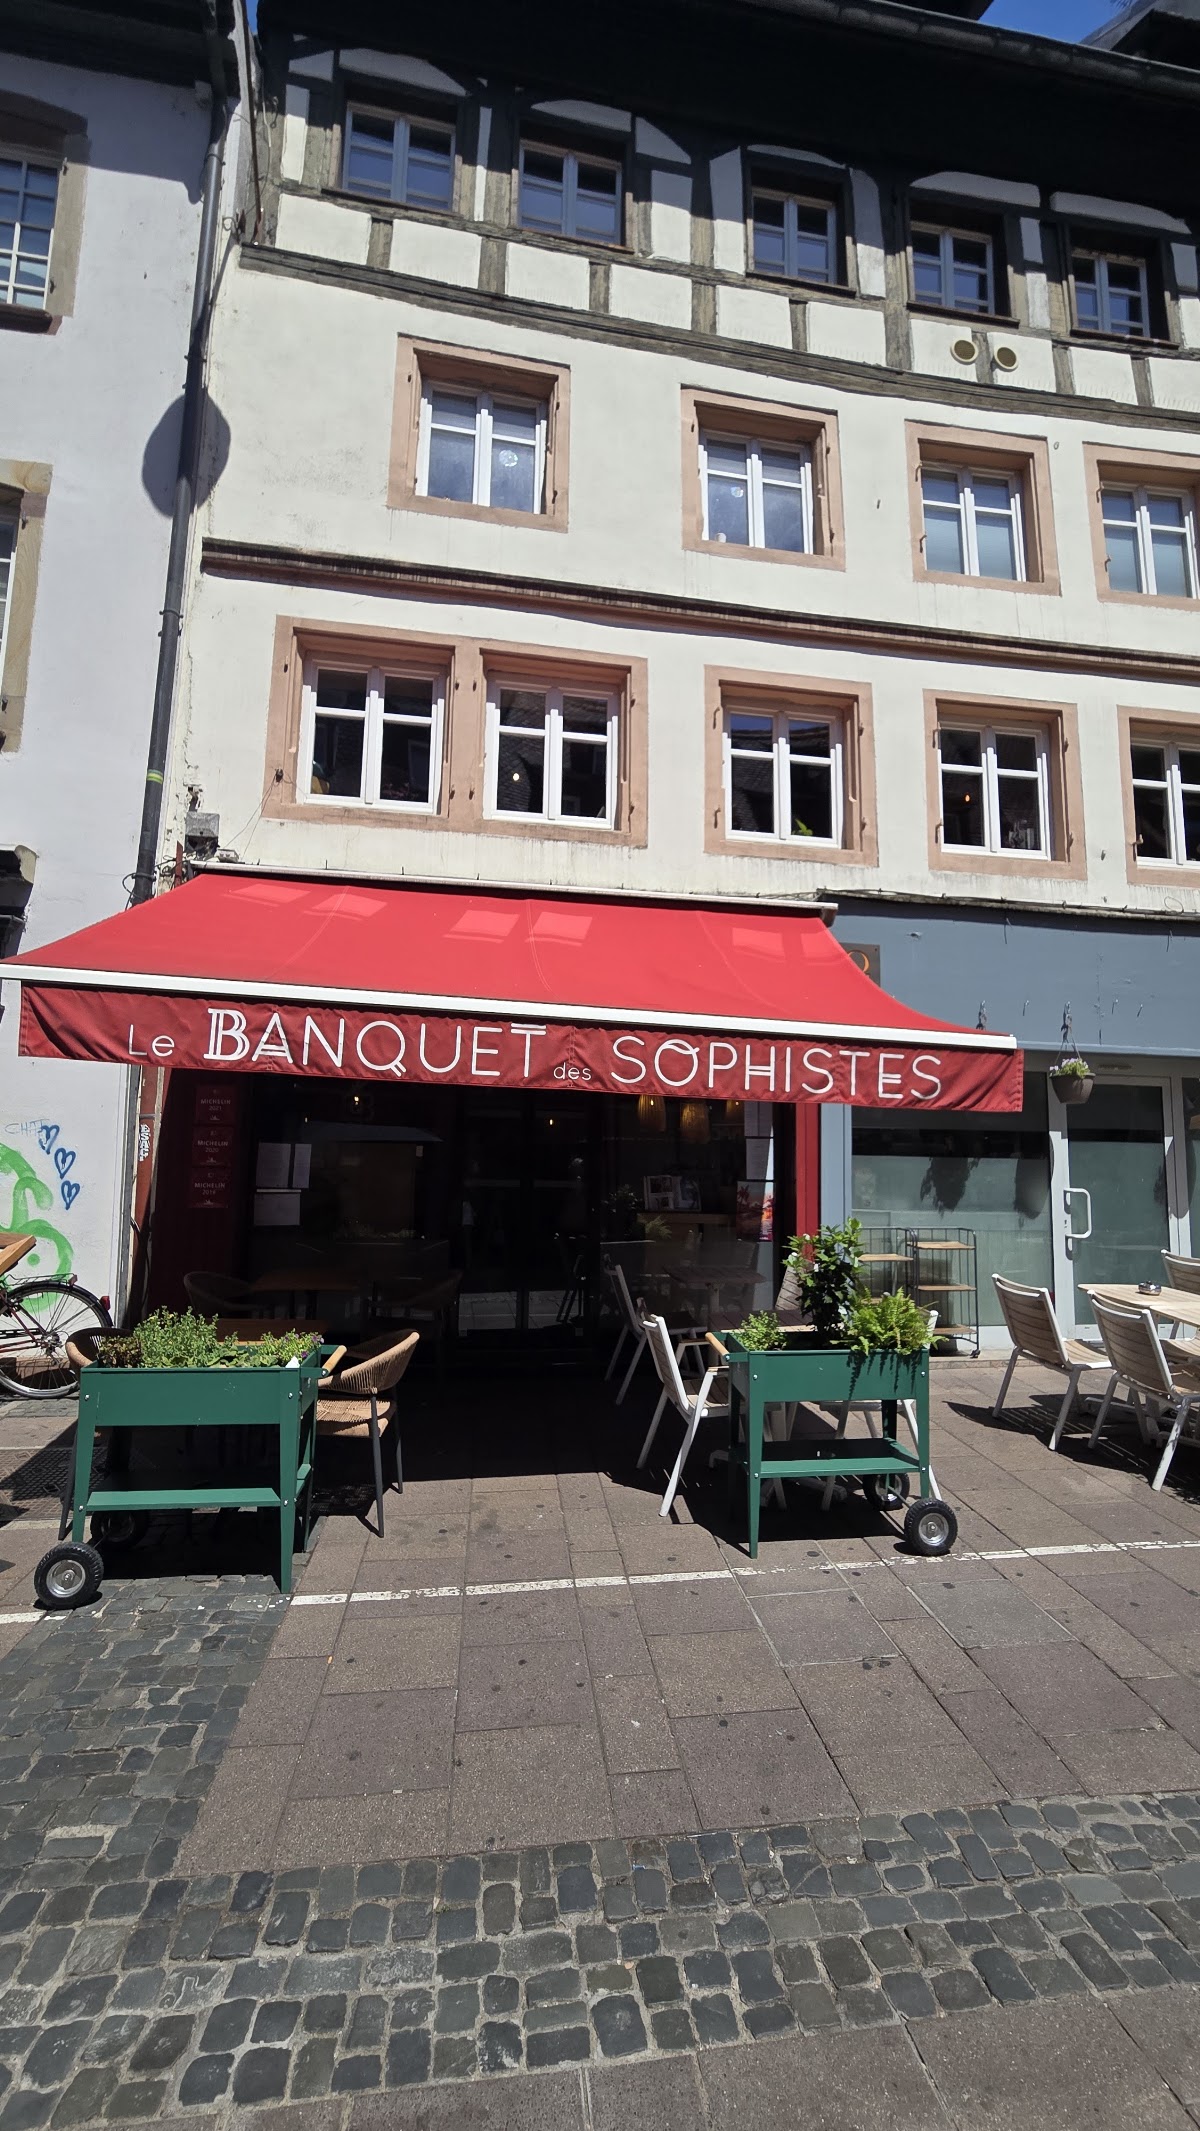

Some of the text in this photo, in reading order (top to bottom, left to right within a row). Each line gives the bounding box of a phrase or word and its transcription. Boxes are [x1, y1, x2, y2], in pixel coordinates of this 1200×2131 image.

[128, 1008, 941, 1100] Le BANQUET des SOPHISTES
